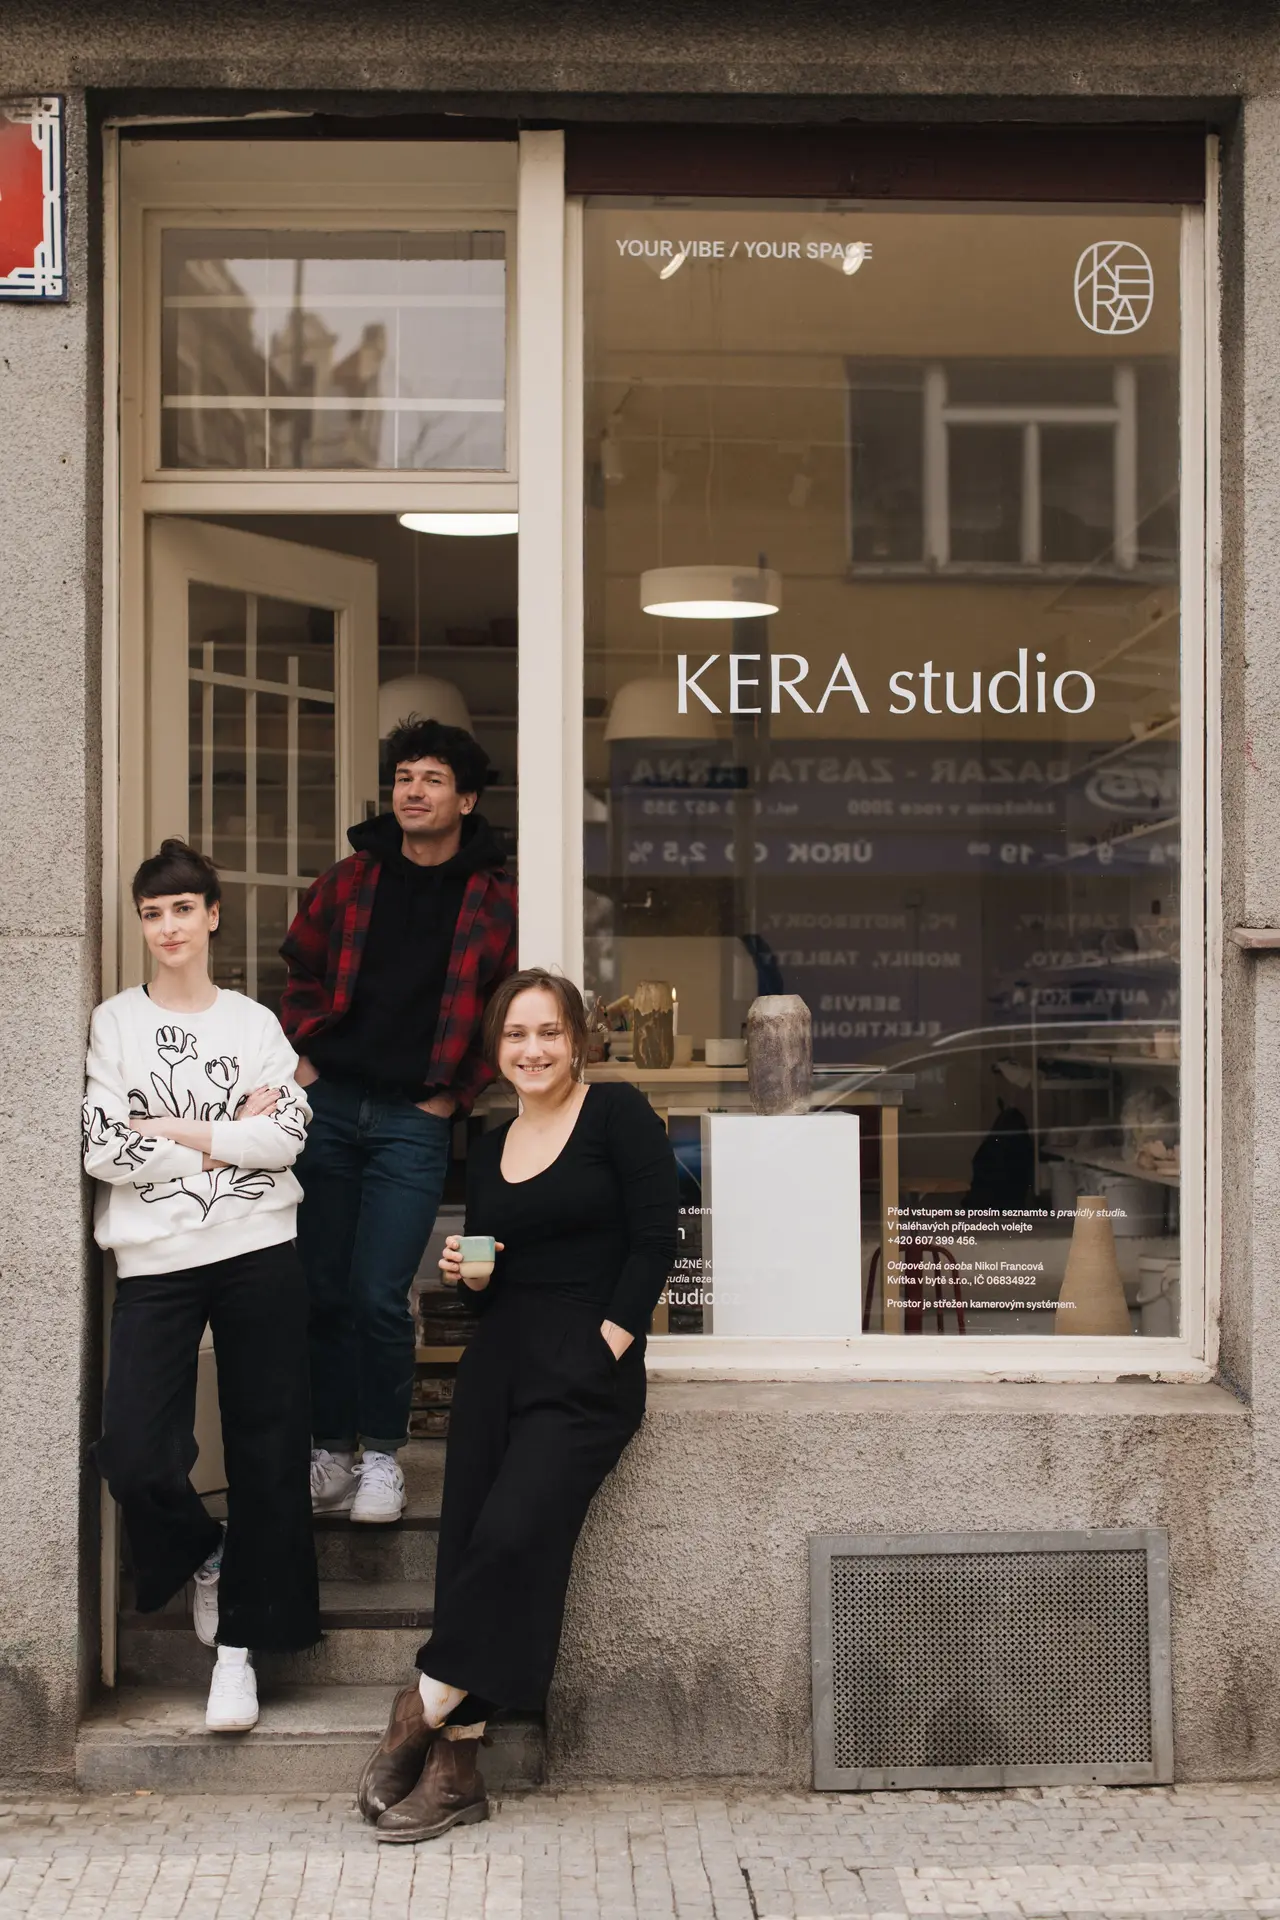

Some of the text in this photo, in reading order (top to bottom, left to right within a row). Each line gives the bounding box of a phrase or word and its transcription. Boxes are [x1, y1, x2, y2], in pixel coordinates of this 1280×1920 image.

[616, 239, 873, 260] YOUR VIBE / YOUR SPACE
[677, 647, 1096, 714] KERA studio
[887, 1206, 909, 1216] Před
[911, 1208, 953, 1218] vstupem
[954, 1209, 966, 1217] se
[967, 1208, 1000, 1218] prosím
[1002, 1208, 1048, 1217] seznamte
[1057, 1208, 1095, 1219] pravidly
[1096, 1208, 1128, 1217] studia.
[887, 1221, 1033, 1233] V naléhavých případech volejte
[887, 1236, 978, 1245] +420 607 399 456.
[887, 1261, 1044, 1272] Odpovědná osoba Nikol Francová
[887, 1275, 916, 1285] Kvítka
[917, 1277, 924, 1285] v
[925, 1275, 946, 1287] bytě
[974, 1274, 985, 1285] IČ
[986, 1276, 1036, 1285] 06834922
[887, 1299, 1077, 1310] Prostor je střežen kamerovým systémem.
